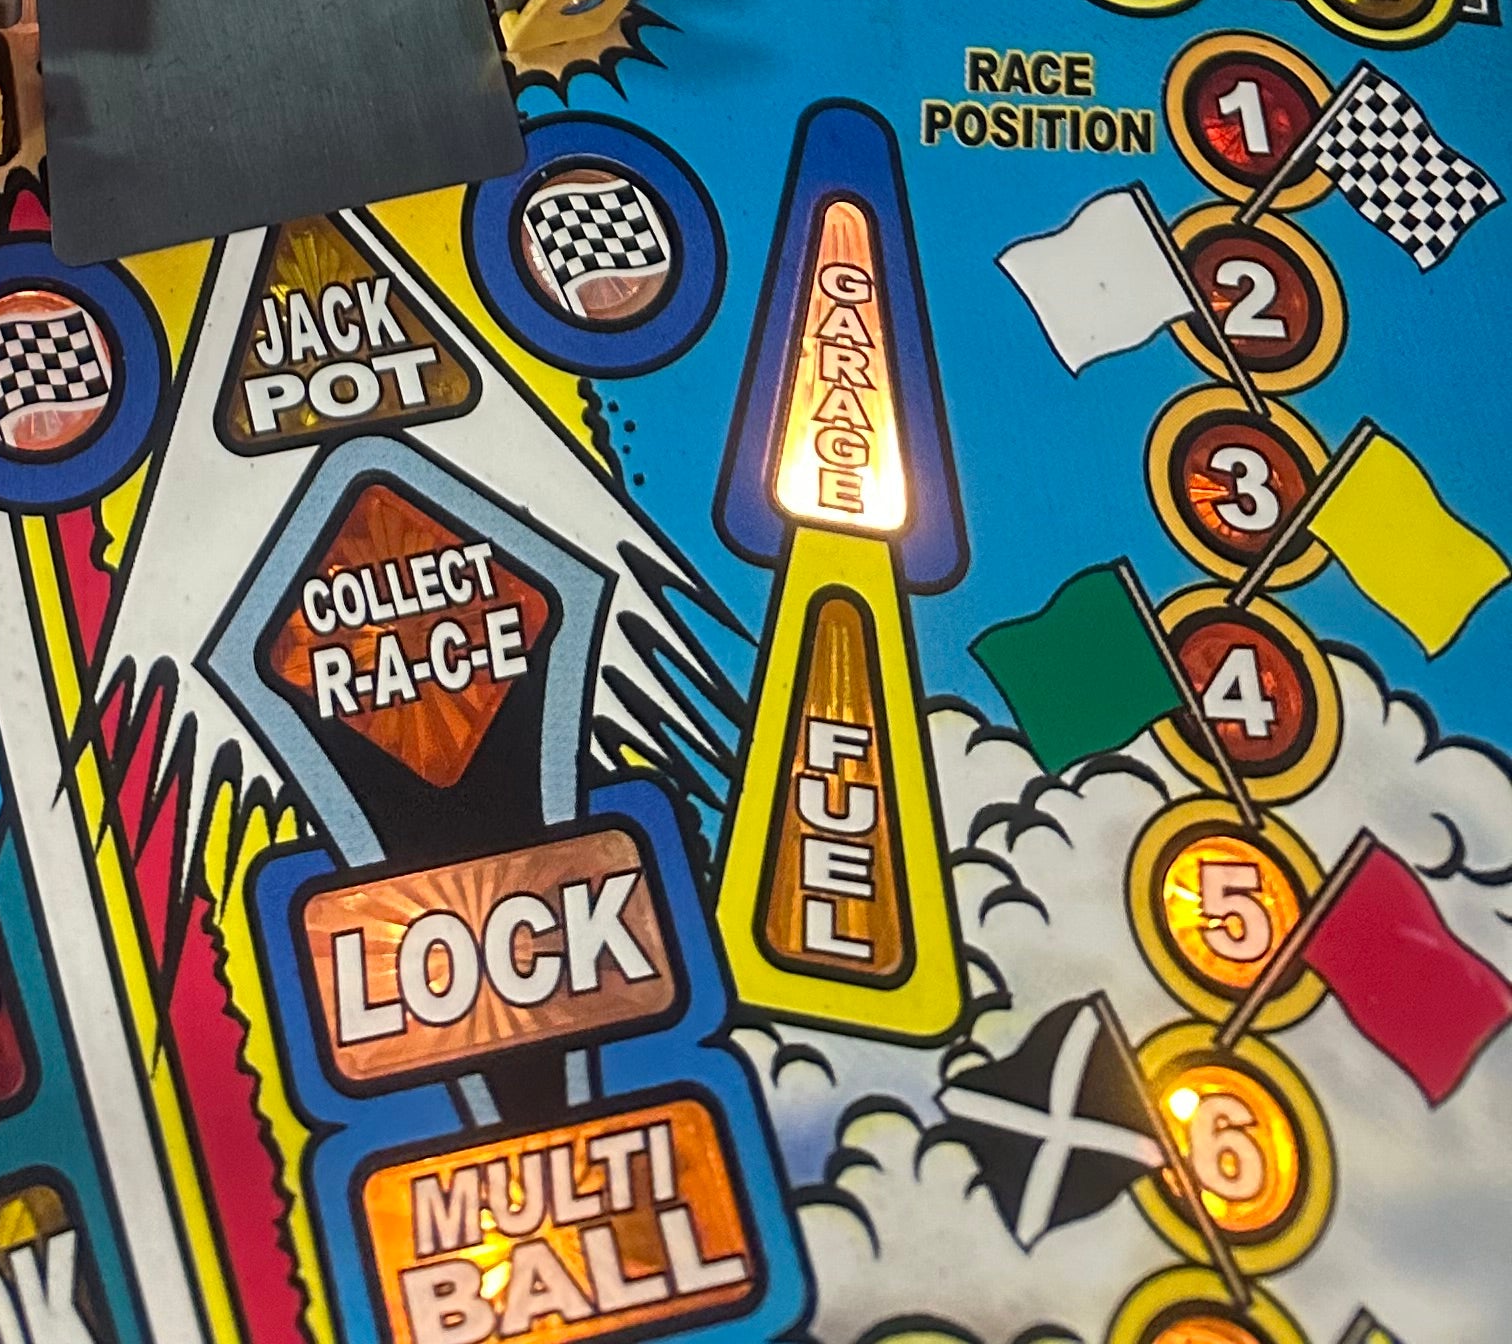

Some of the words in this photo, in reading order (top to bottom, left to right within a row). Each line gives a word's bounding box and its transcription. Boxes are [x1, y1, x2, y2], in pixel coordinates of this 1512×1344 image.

[966, 48, 1094, 97] RACE
[1218, 79, 1272, 156] 1
[922, 103, 1156, 154] POSITION
[255, 277, 408, 367] JACK
[1214, 257, 1287, 340] 2
[243, 347, 440, 435] POT
[815, 261, 874, 513] GARAGE
[1208, 445, 1282, 532] 3
[301, 543, 495, 634] COLLECT
[310, 607, 528, 719] R-A-C-E
[1201, 642, 1278, 740] 4
[797, 720, 876, 960] FUEL
[333, 867, 660, 1046] LOCK
[1198, 861, 1273, 963] 5
[411, 1120, 676, 1259] MULTI
[1189, 1091, 1264, 1202] 6
[400, 1208, 748, 1344] BALL
